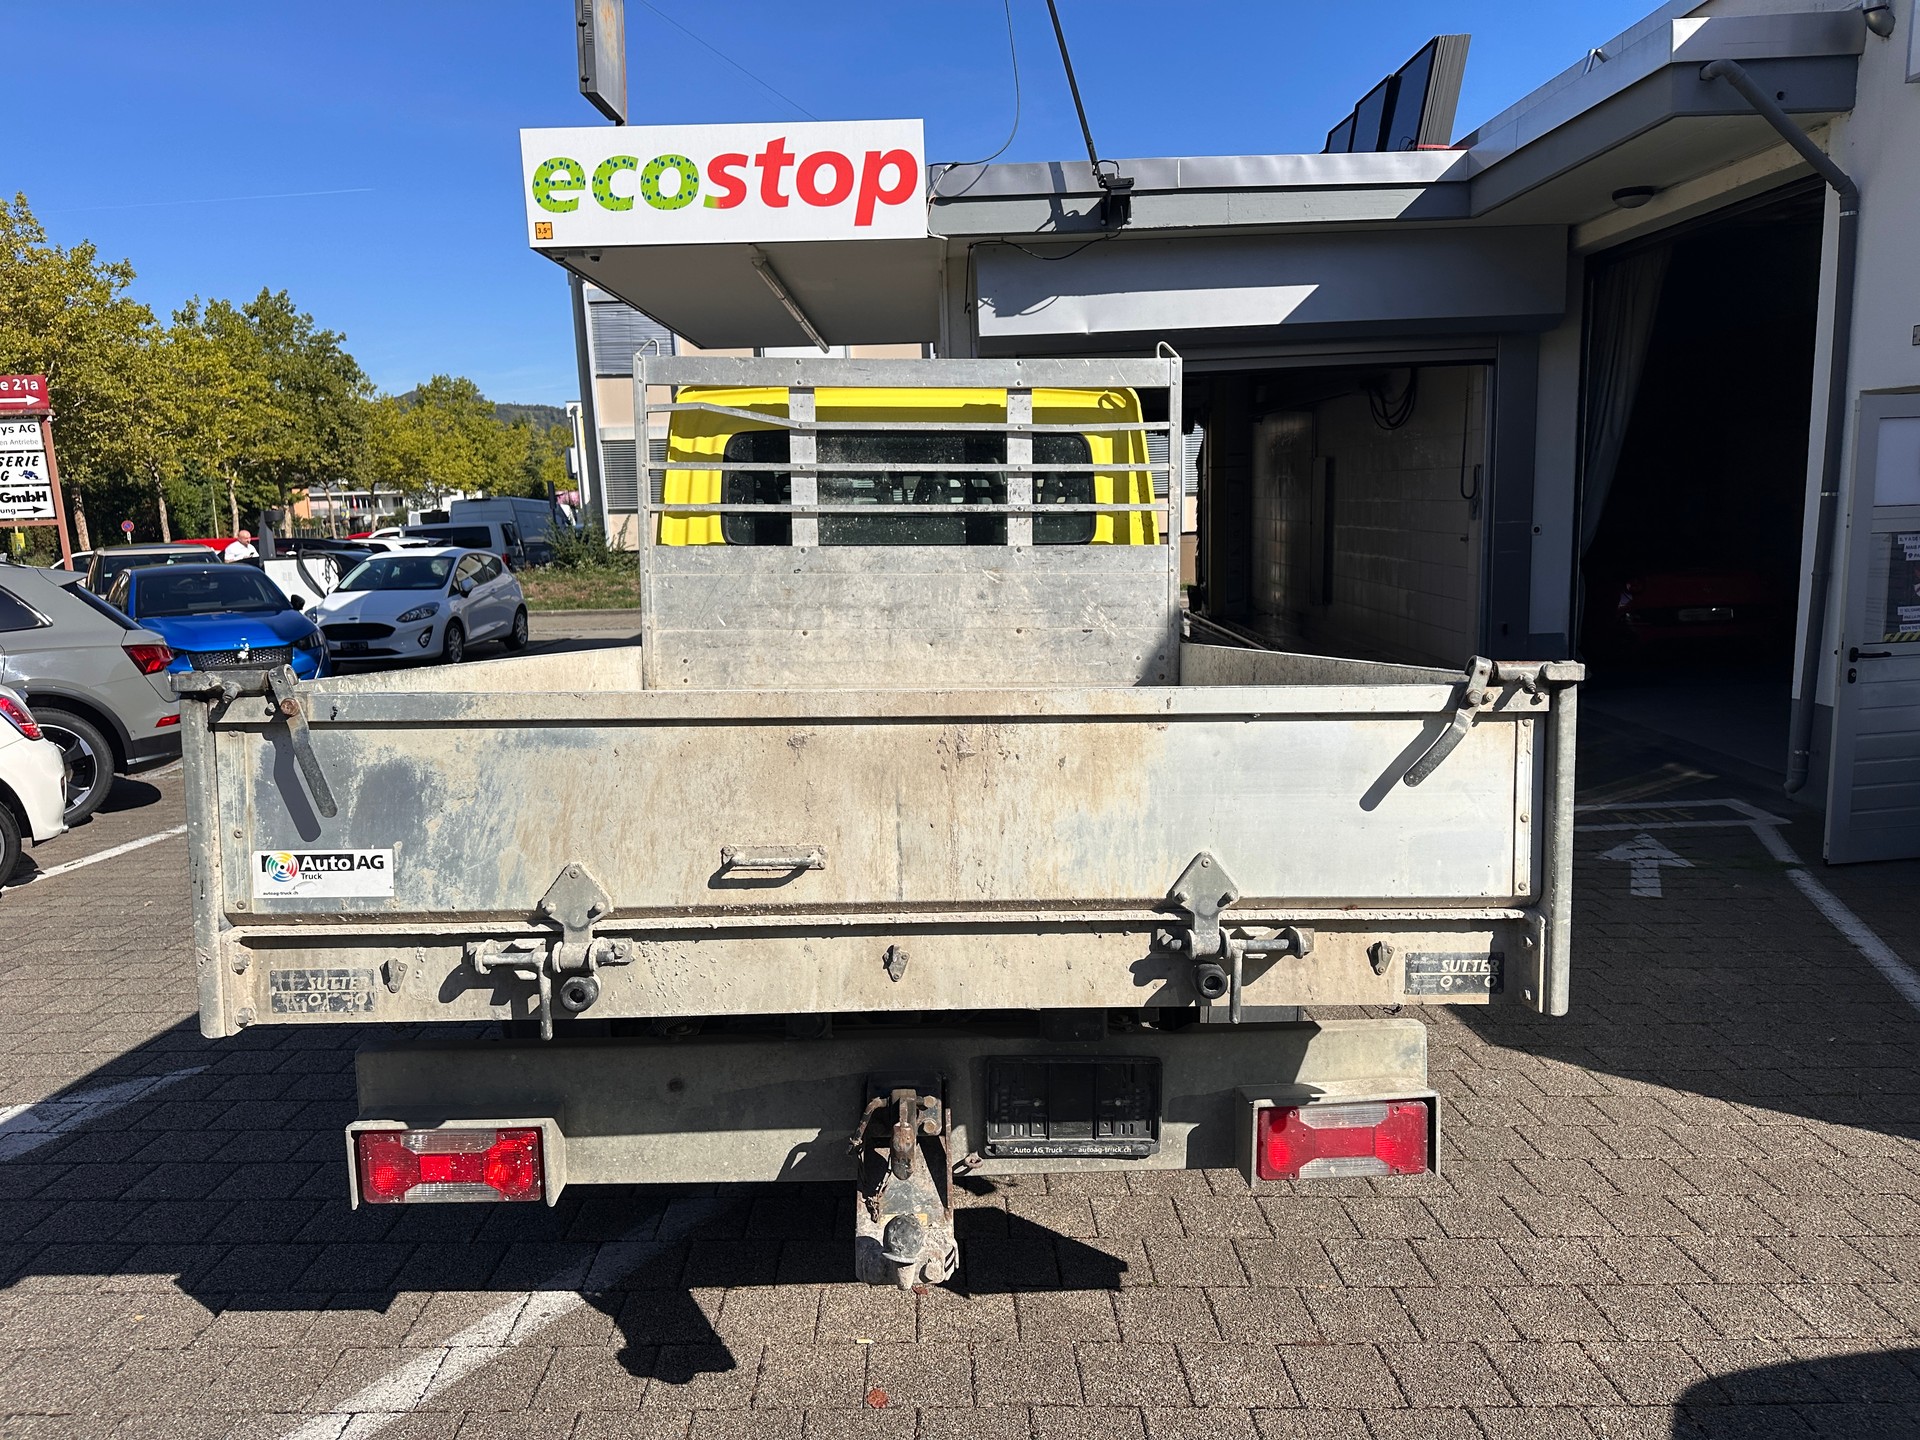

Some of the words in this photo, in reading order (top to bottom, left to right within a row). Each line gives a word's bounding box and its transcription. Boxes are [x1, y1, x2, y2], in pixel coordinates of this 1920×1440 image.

[532, 136, 918, 227] ecostop
[12, 378, 39, 390] 21a
[19, 424, 36, 433] AG
[301, 855, 351, 871] Auto
[356, 855, 385, 870] AG
[1013, 1146, 1031, 1154] Auto
[1032, 1146, 1044, 1154] AG
[1045, 1146, 1063, 1154] Truck
